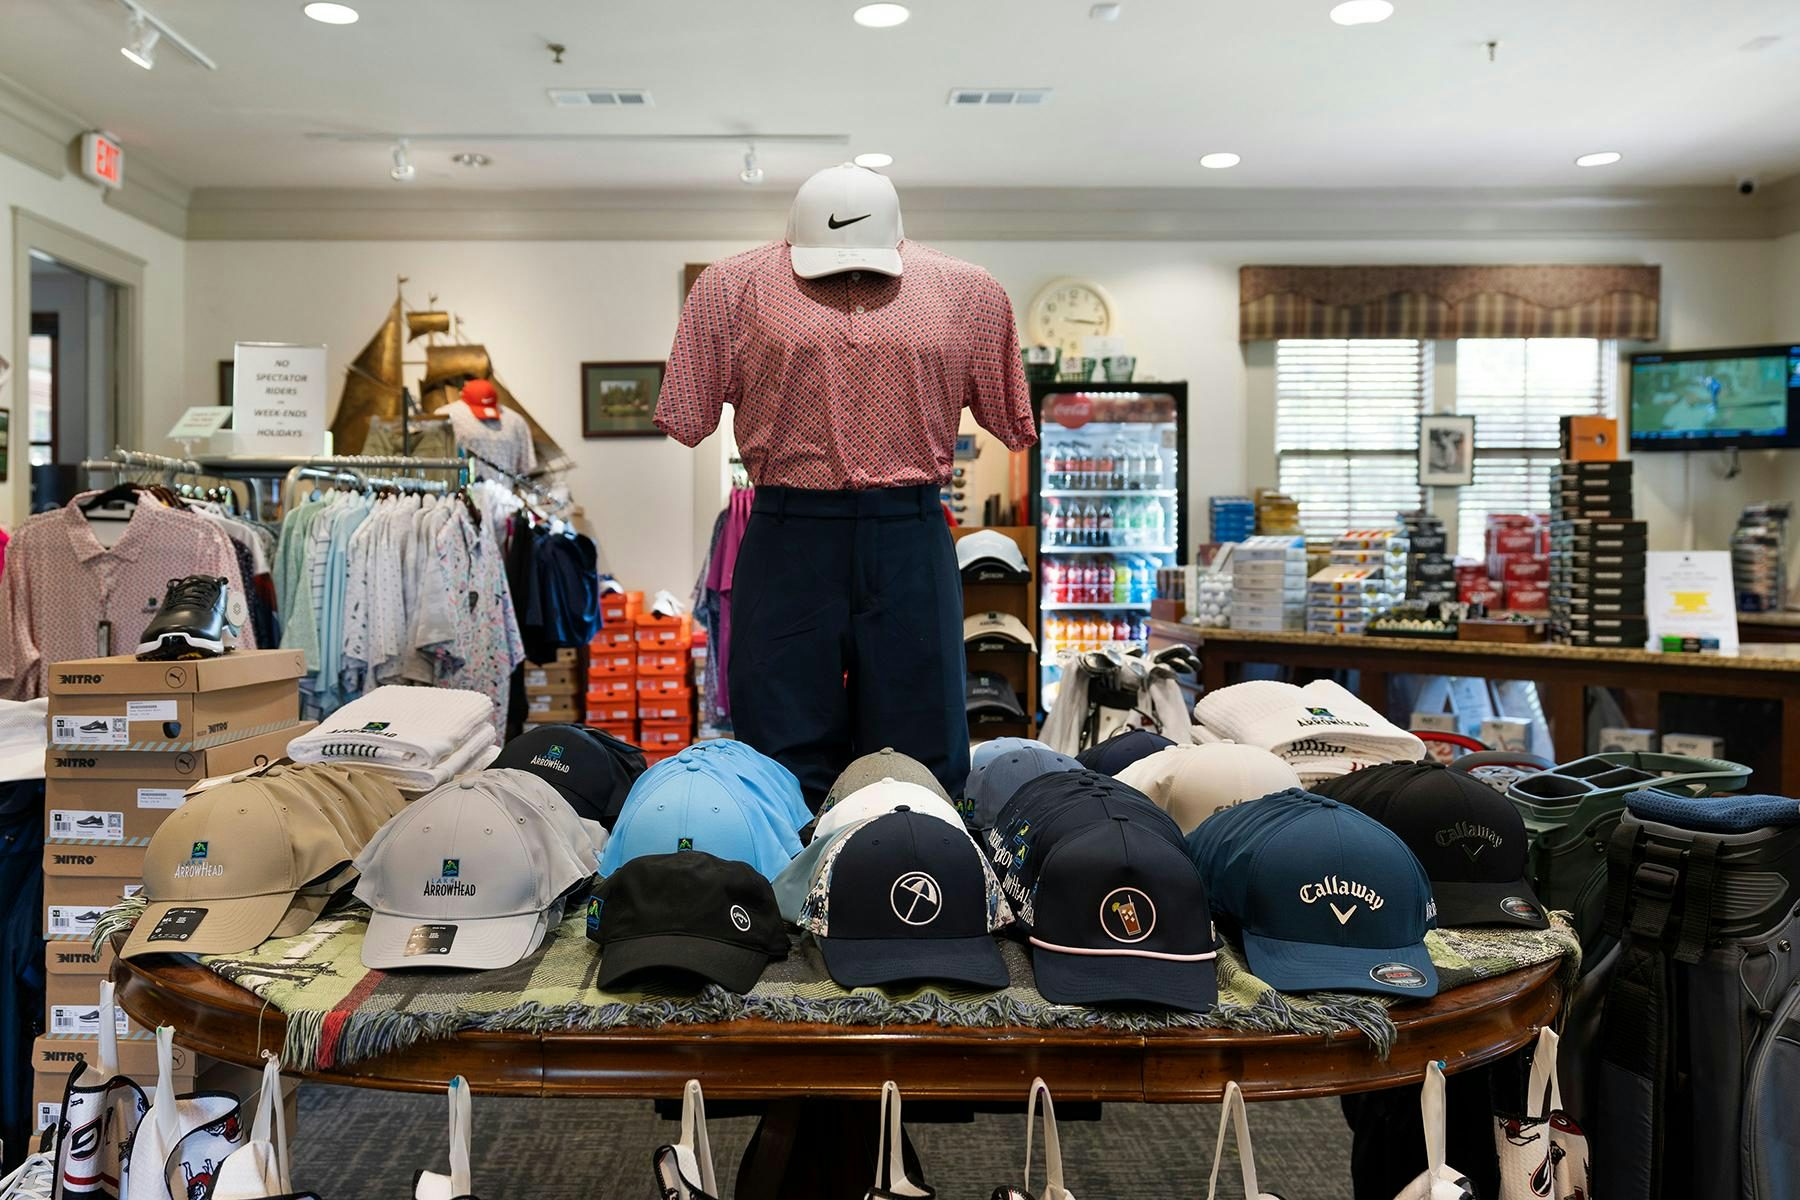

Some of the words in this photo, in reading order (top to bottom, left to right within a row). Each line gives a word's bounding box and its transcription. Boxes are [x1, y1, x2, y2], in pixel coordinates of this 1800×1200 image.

[96, 138, 121, 183] EXIT
[274, 359, 290, 368] NO
[255, 373, 308, 382] SPECTATOR
[265, 387, 298, 395] RIDERS
[257, 429, 303, 437] HOLIDAYS
[57, 674, 102, 684] NITRO
[208, 721, 228, 734] NITRO
[53, 757, 97, 768] NITRO
[1435, 820, 1503, 849] Callaway
[51, 855, 95, 865] NITRO
[174, 861, 224, 879] ARROWHEAD
[423, 880, 477, 897] ARROWHEAD
[1300, 874, 1384, 911] Callaway
[42, 1051, 85, 1061] NITRO
